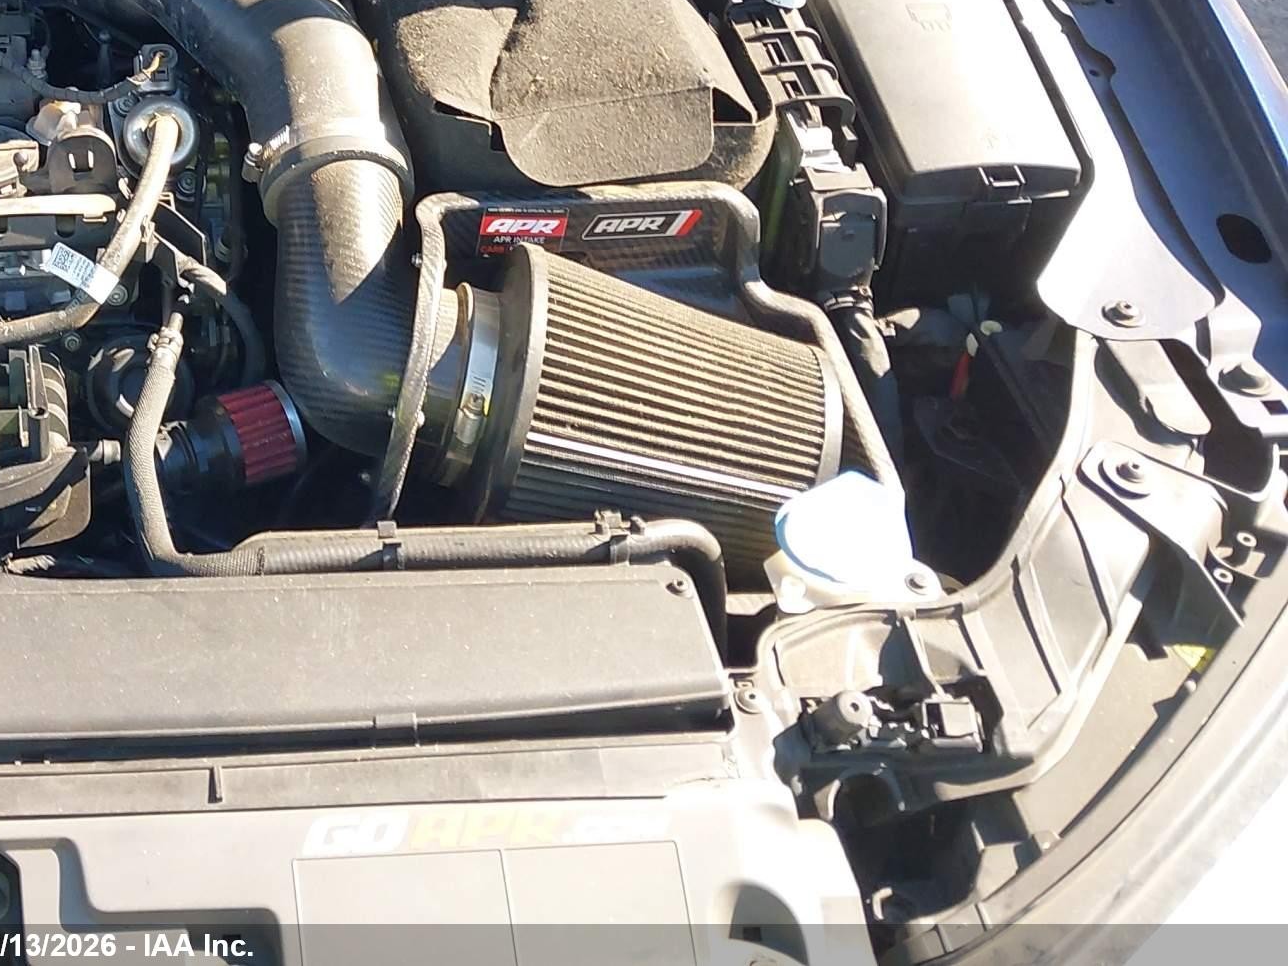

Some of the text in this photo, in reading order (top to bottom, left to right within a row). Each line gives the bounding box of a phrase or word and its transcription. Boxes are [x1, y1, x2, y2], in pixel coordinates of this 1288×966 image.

[486, 218, 561, 234] APR
[593, 217, 665, 234] APR
[493, 235, 512, 244] APR
